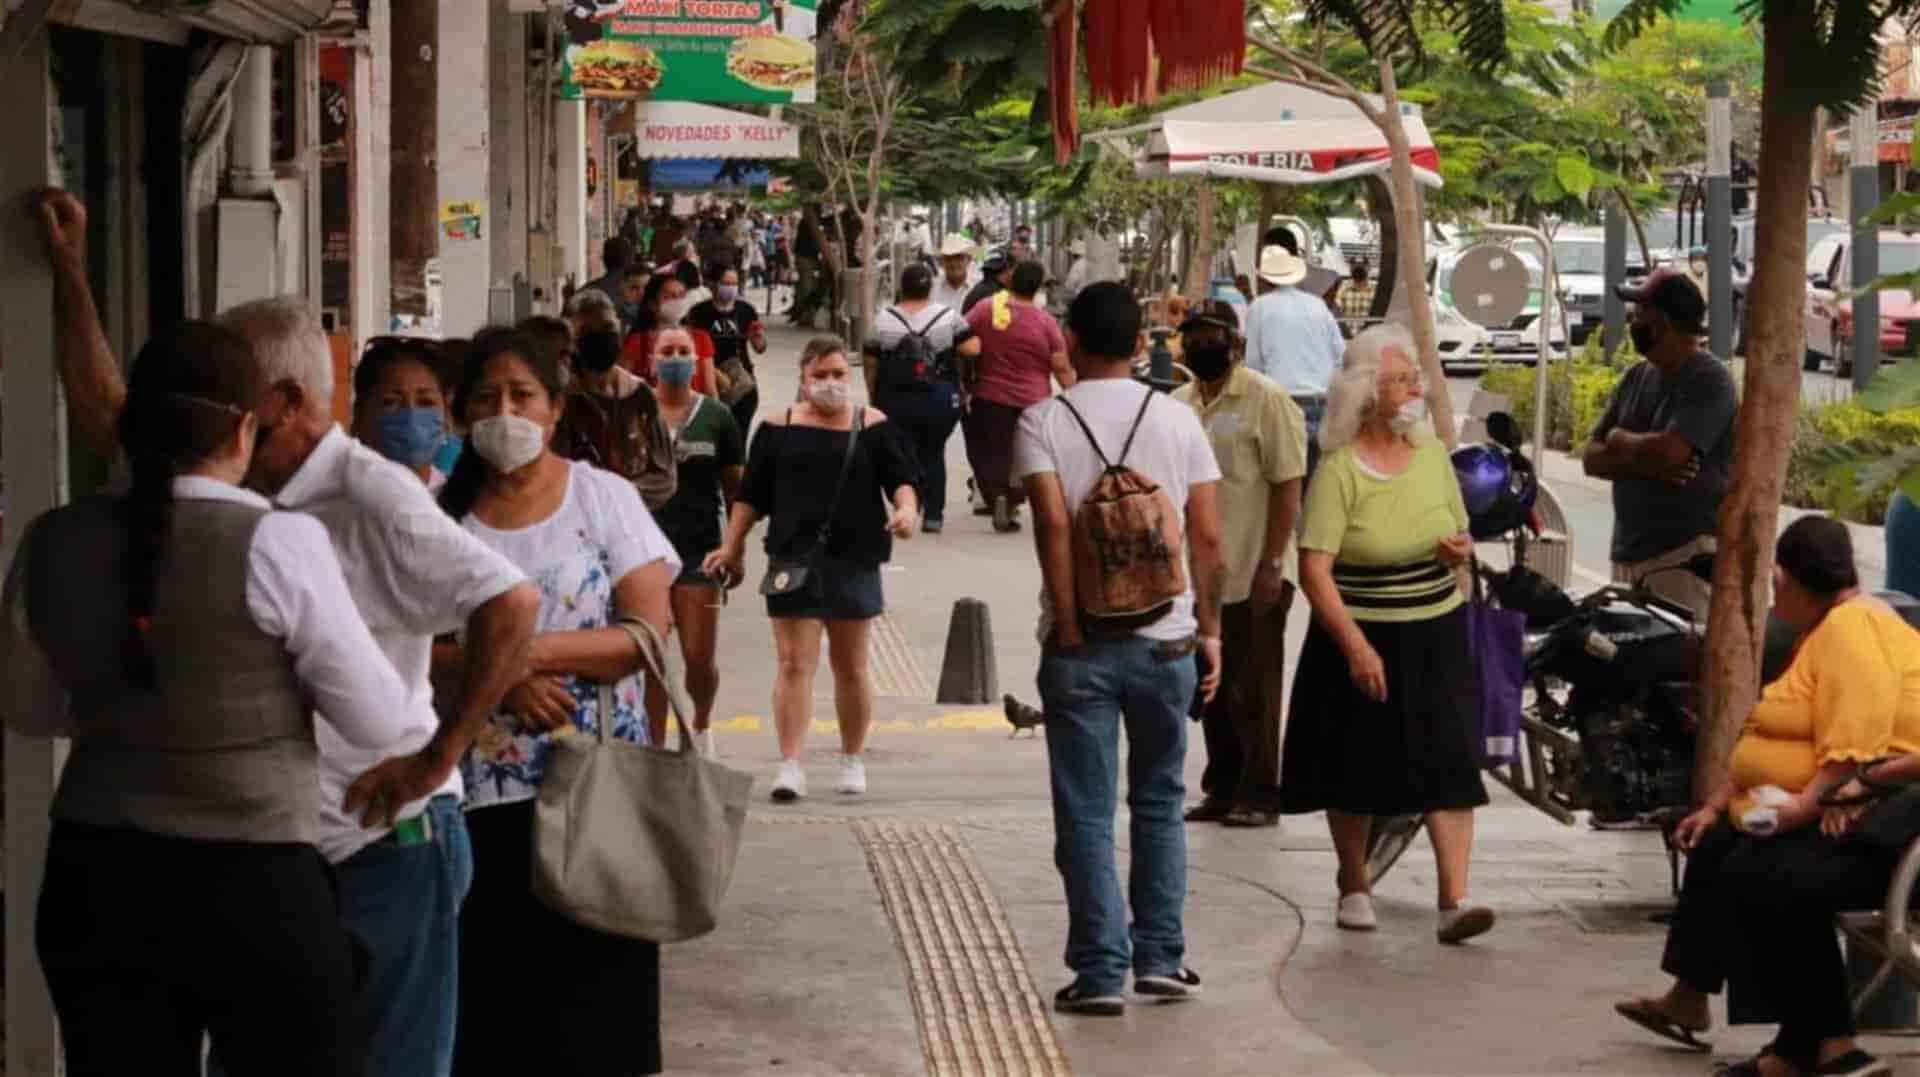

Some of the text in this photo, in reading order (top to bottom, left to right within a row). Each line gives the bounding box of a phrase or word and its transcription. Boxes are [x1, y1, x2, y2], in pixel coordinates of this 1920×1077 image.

[685, 1, 760, 17] TORTAS
[645, 124, 791, 141] NOVEDADES "KELLY"
